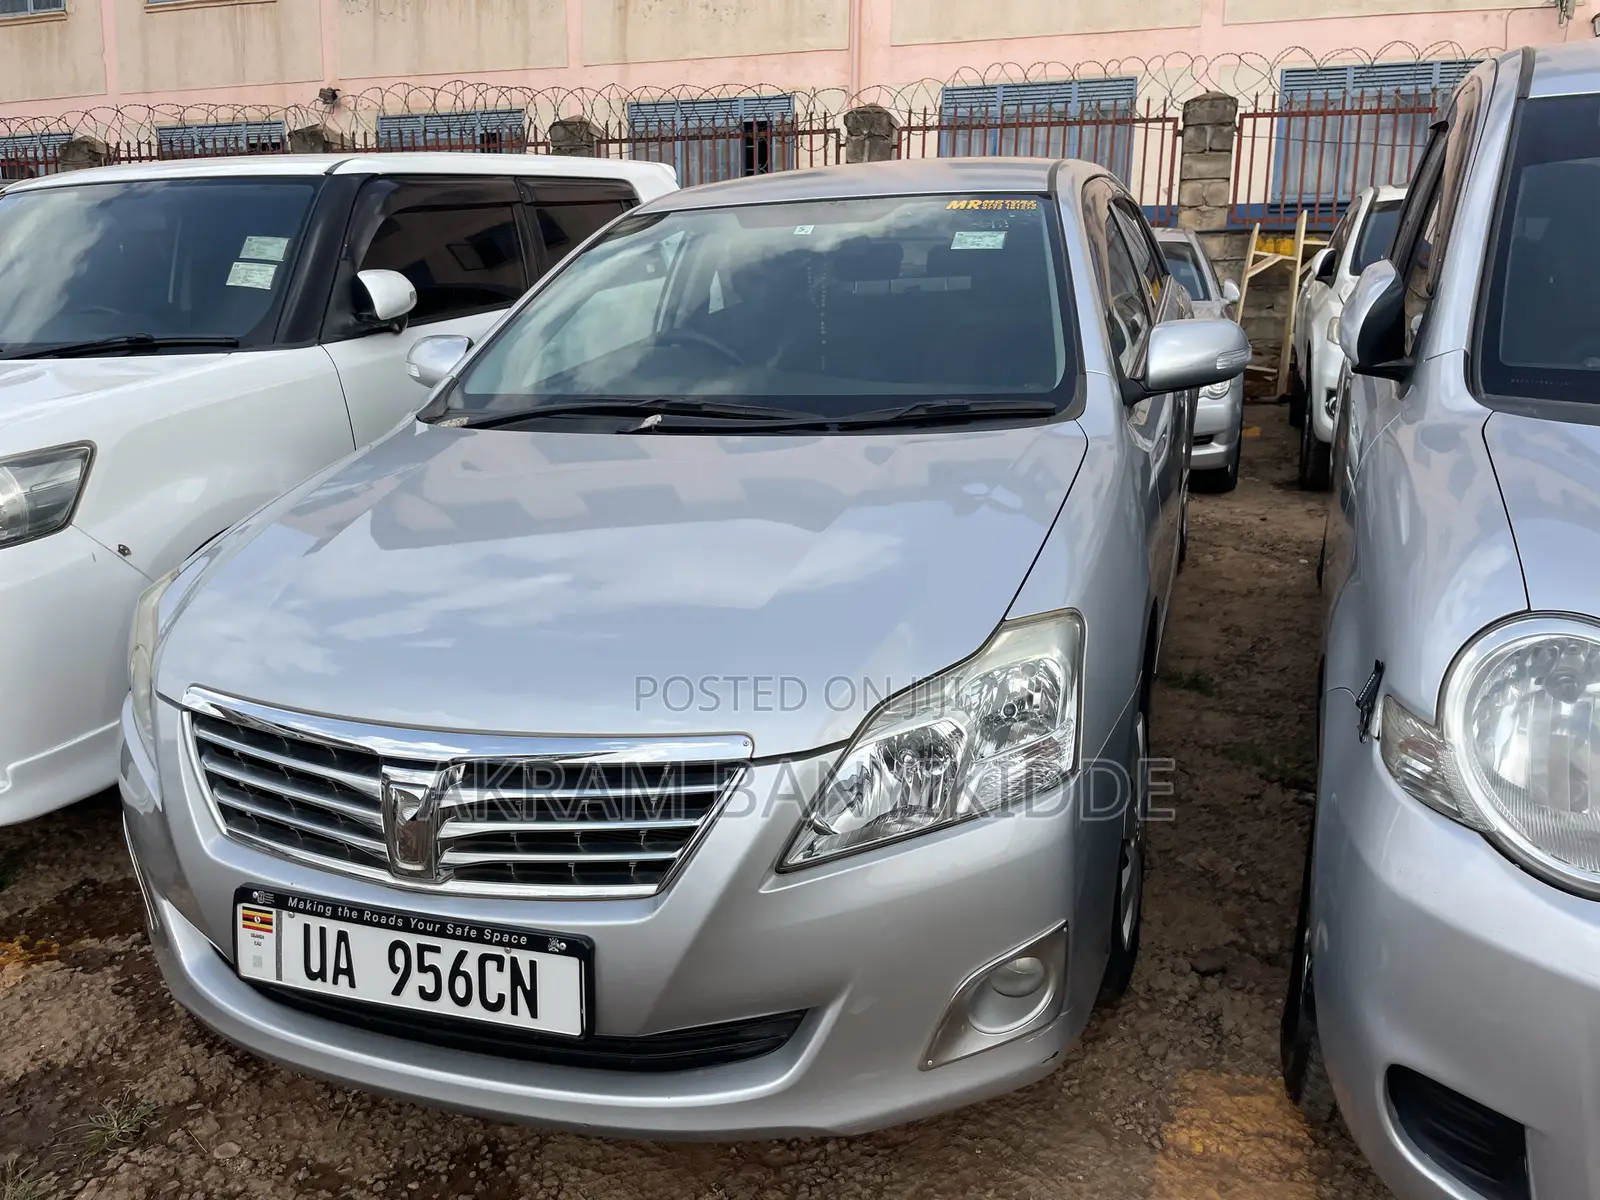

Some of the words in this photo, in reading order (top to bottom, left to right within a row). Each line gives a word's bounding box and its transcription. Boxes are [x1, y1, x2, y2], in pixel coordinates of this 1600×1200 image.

[288, 897, 332, 916] Making
[338, 906, 358, 919] the
[364, 911, 403, 926] Roads
[409, 917, 440, 932] Your
[446, 923, 477, 938] Safe
[484, 929, 527, 944] Space
[304, 922, 356, 989] UA
[388, 939, 538, 1019] 956CN
